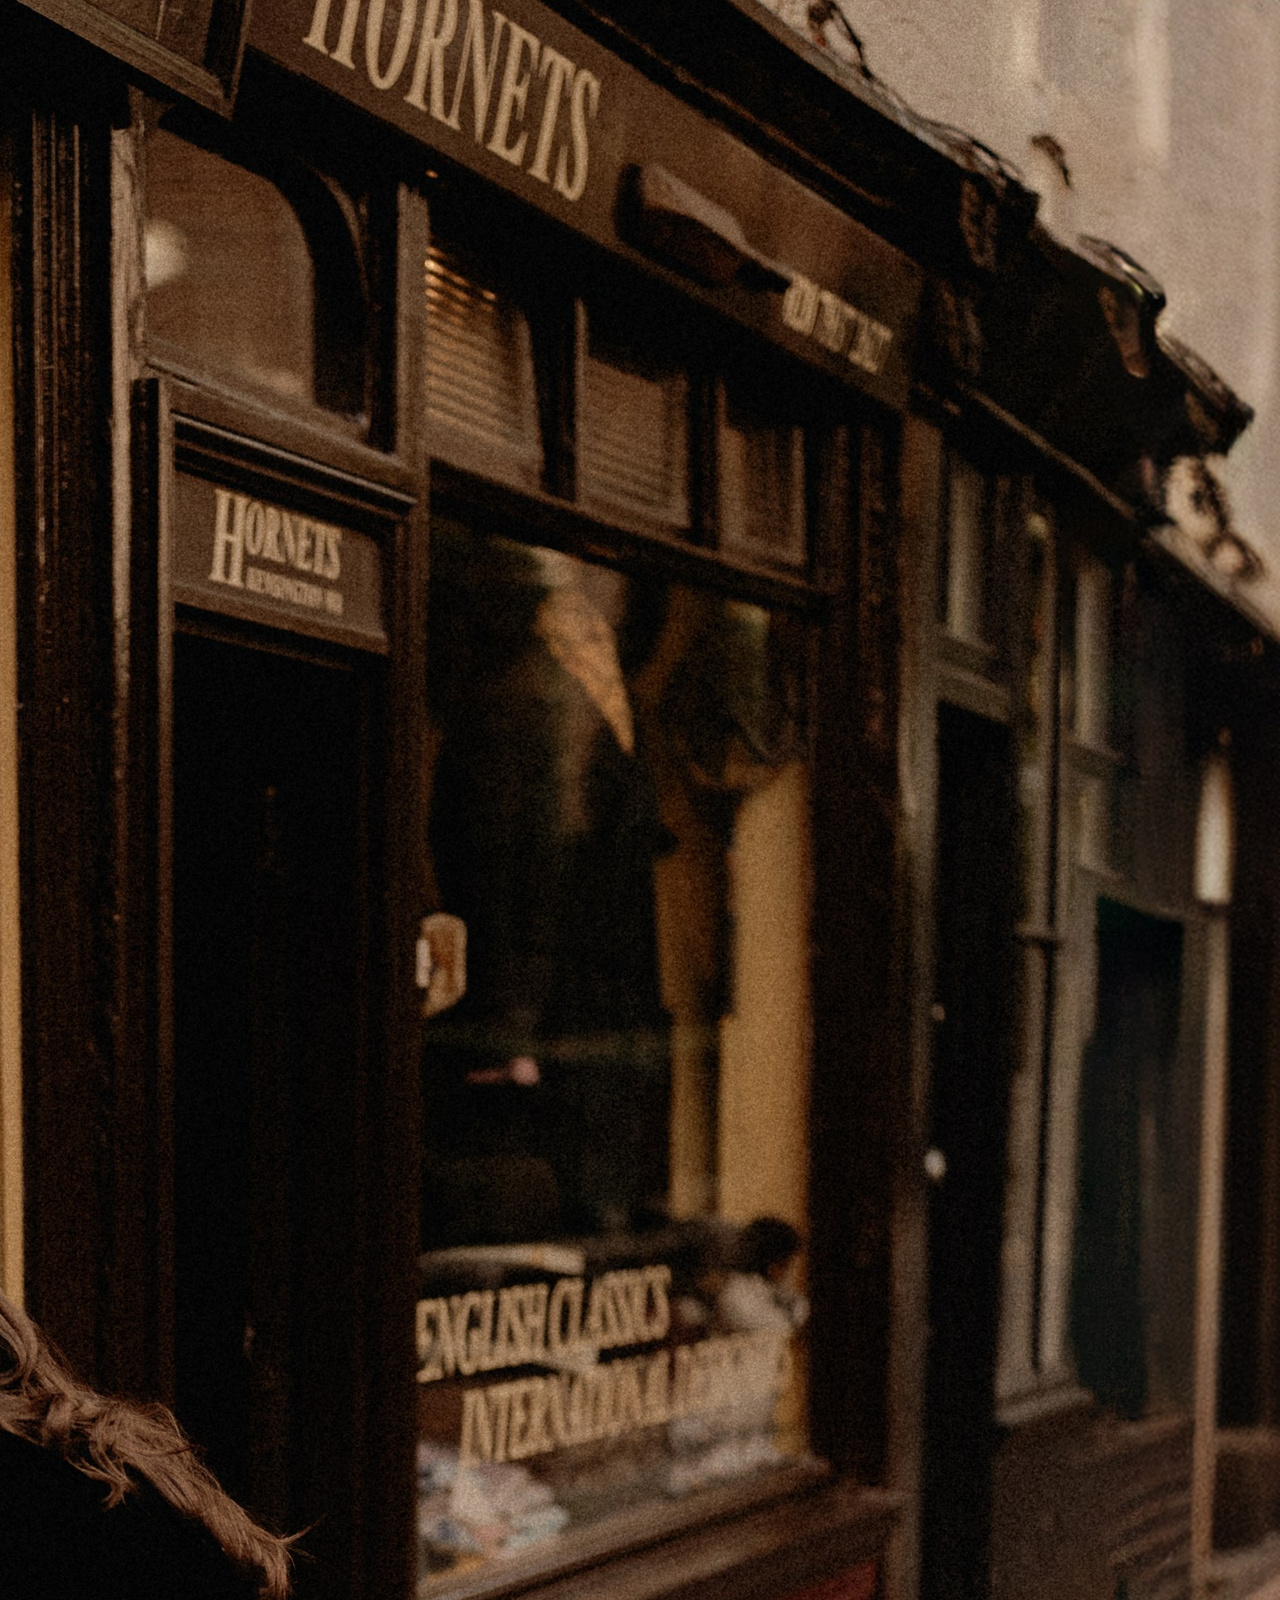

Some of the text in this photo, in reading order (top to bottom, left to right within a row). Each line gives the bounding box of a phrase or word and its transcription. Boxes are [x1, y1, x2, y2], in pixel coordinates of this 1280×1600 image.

[209, 488, 343, 588] HORNETS
[415, 1264, 672, 1385] ENGLISH CLASSICS
